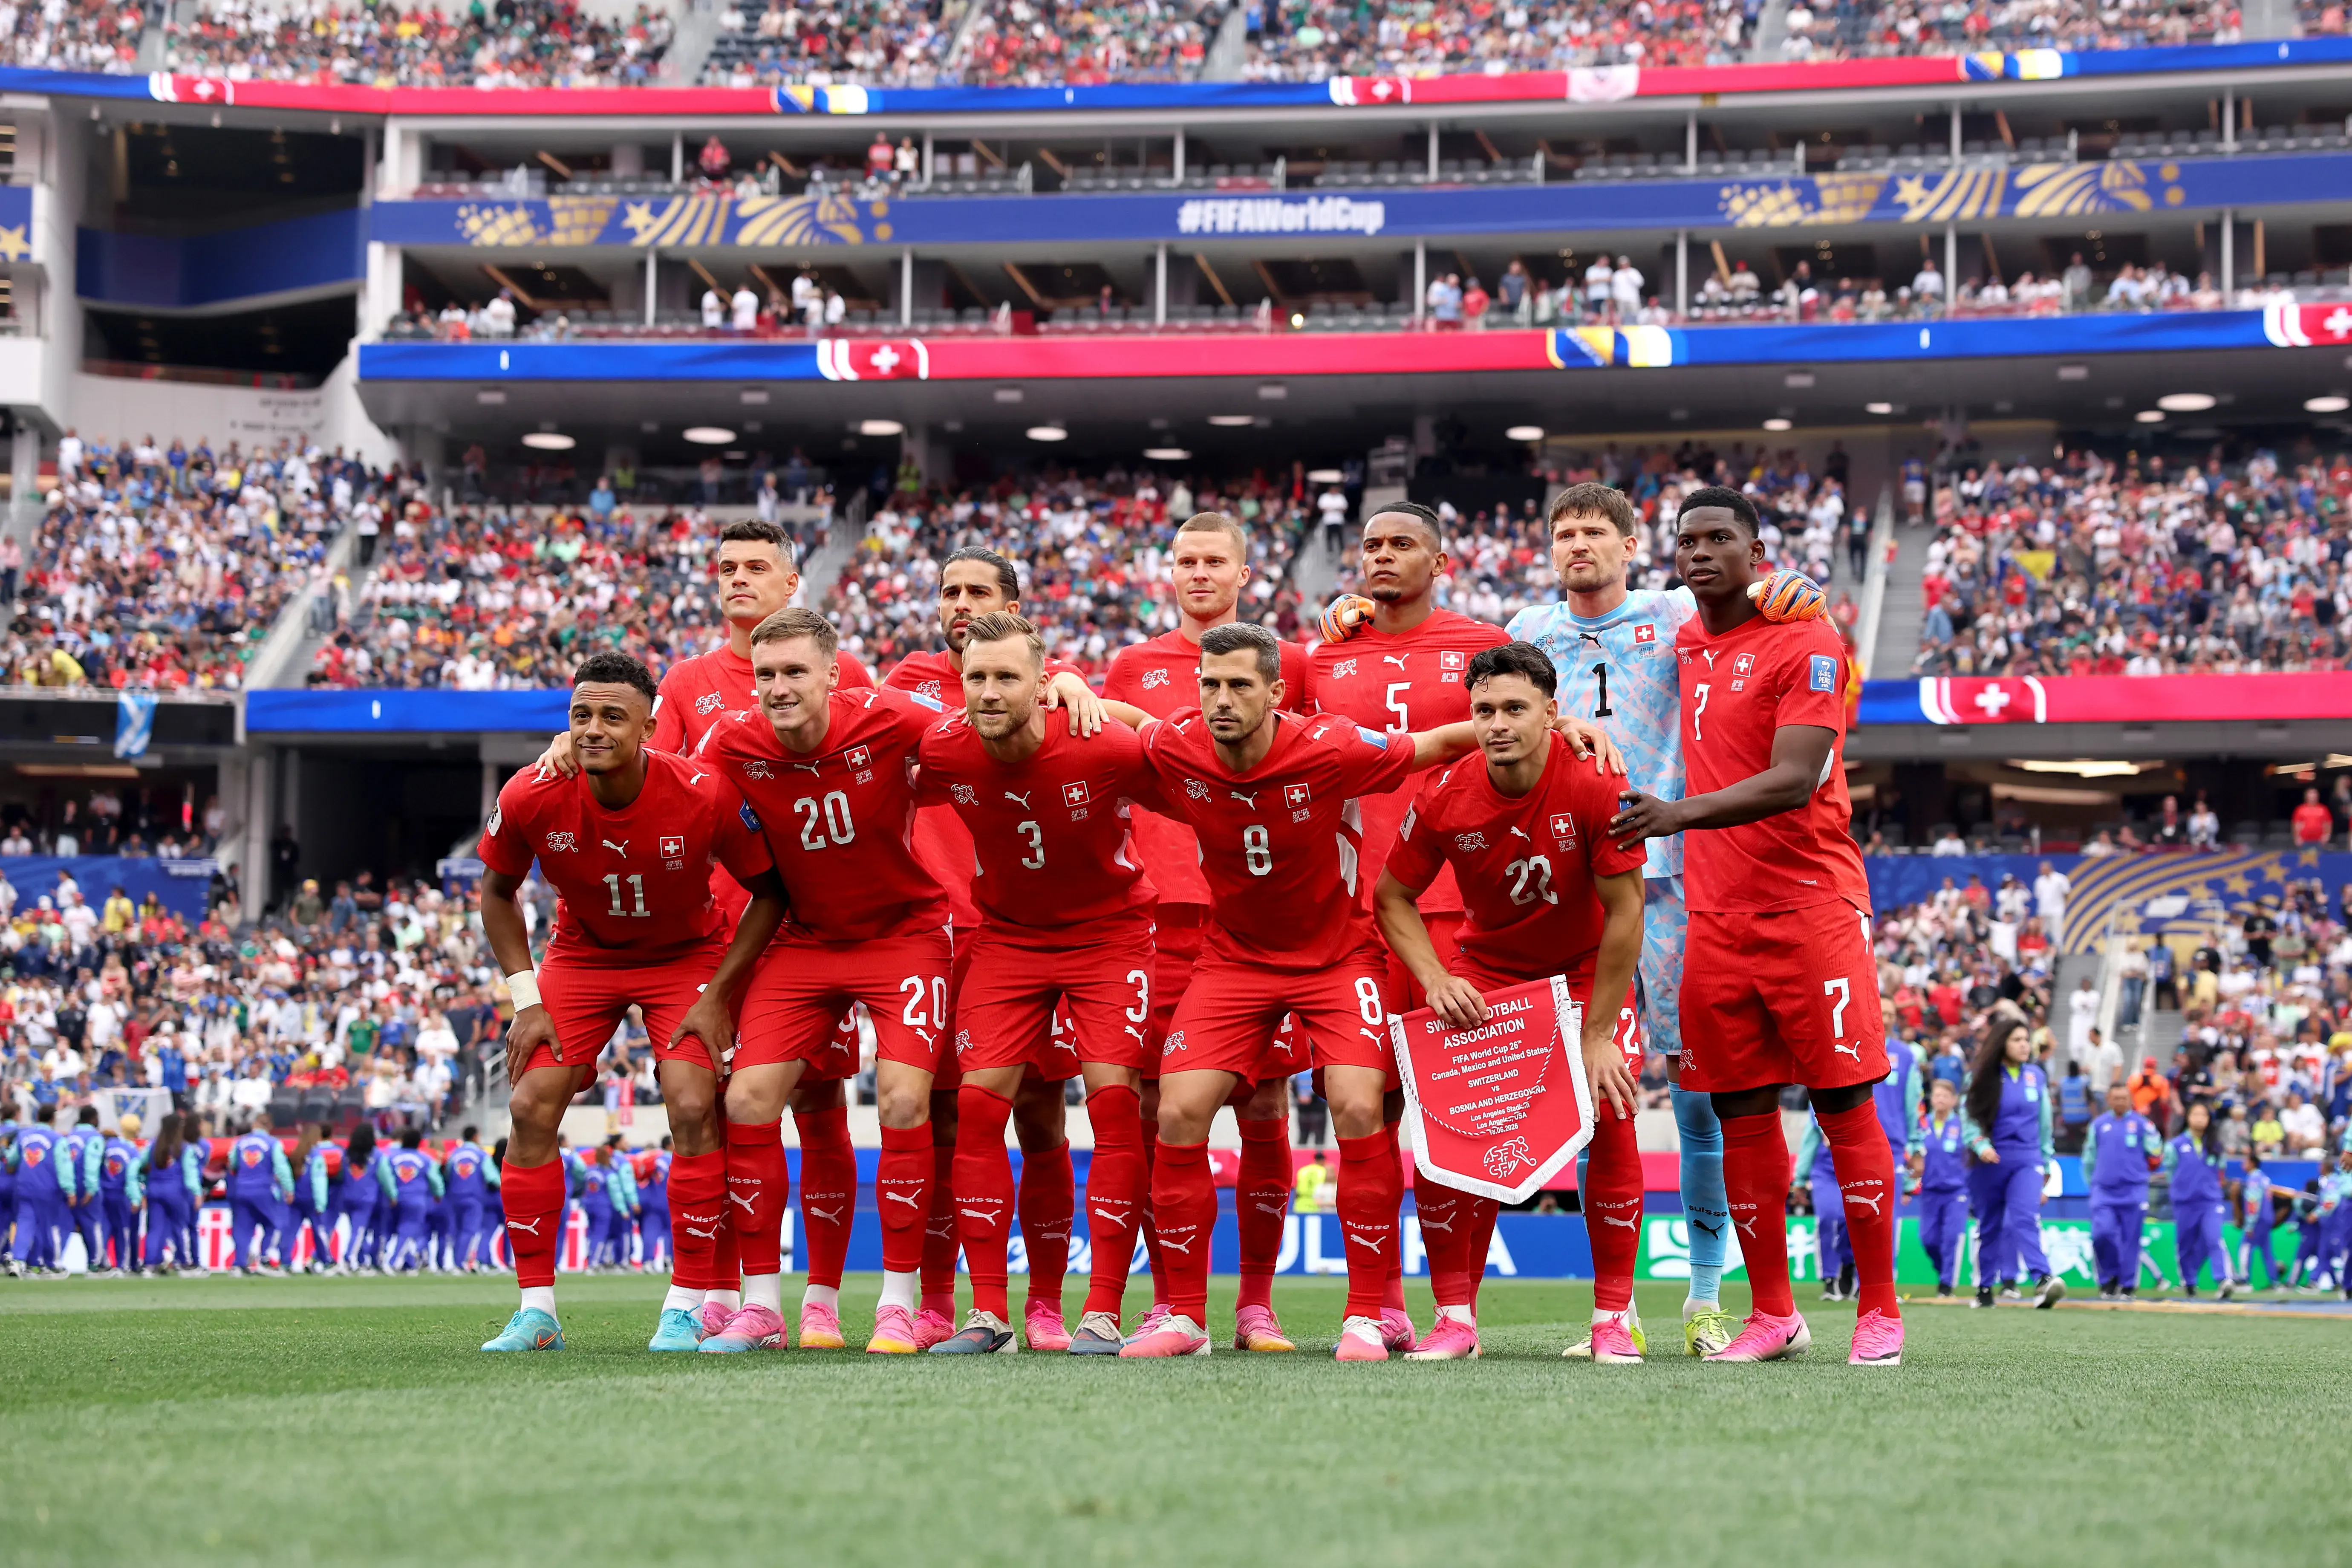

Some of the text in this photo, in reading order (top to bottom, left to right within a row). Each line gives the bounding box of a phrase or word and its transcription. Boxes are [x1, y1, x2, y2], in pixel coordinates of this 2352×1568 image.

[1177, 196, 1385, 235] #FIFAWorldCup
[1760, 575, 1778, 609] eusch
[1385, 682, 1412, 733] 5
[1592, 663, 1612, 718] 1
[1694, 683, 1711, 741] 7
[794, 790, 855, 851] 20
[1017, 821, 1045, 869] 3
[1244, 825, 1272, 876] 8
[602, 874, 650, 917] 11
[1505, 854, 1558, 905] 22
[900, 975, 947, 1031] 20
[1125, 970, 1149, 1023] 3
[1354, 977, 1383, 1026] 8
[1824, 977, 1850, 1039] 7
[1426, 997, 1534, 1034] SWI OTBALL
[1612, 1007, 1640, 1056] 2
[1444, 1017, 1525, 1050] ASSOCIATION
[1431, 1046, 1549, 1081] Canada, Mexico and United States
[1452, 1054, 1470, 1065] FIFA
[1469, 1048, 1492, 1060] World
[1493, 1045, 1509, 1055] Cup
[1468, 1068, 1519, 1088] SWITZERLAND
[1449, 1101, 1478, 1115] BOSNIA
[1478, 1097, 1493, 1109] AND
[1470, 1113, 1482, 1122] Los
[1482, 1108, 1506, 1119] Angeles
[1514, 1112, 1527, 1120] USA
[1489, 1122, 1519, 1136] 18.06.2026
[1090, 1196, 1132, 1205] suisse
[1841, 1179, 1883, 1190] suisse
[683, 1213, 719, 1222] suisse
[1416, 1200, 1456, 1211] suisse
[1596, 1197, 1639, 1209] suisse
[1689, 1205, 1727, 1216] suisse
[1347, 1221, 1389, 1230] suisse
